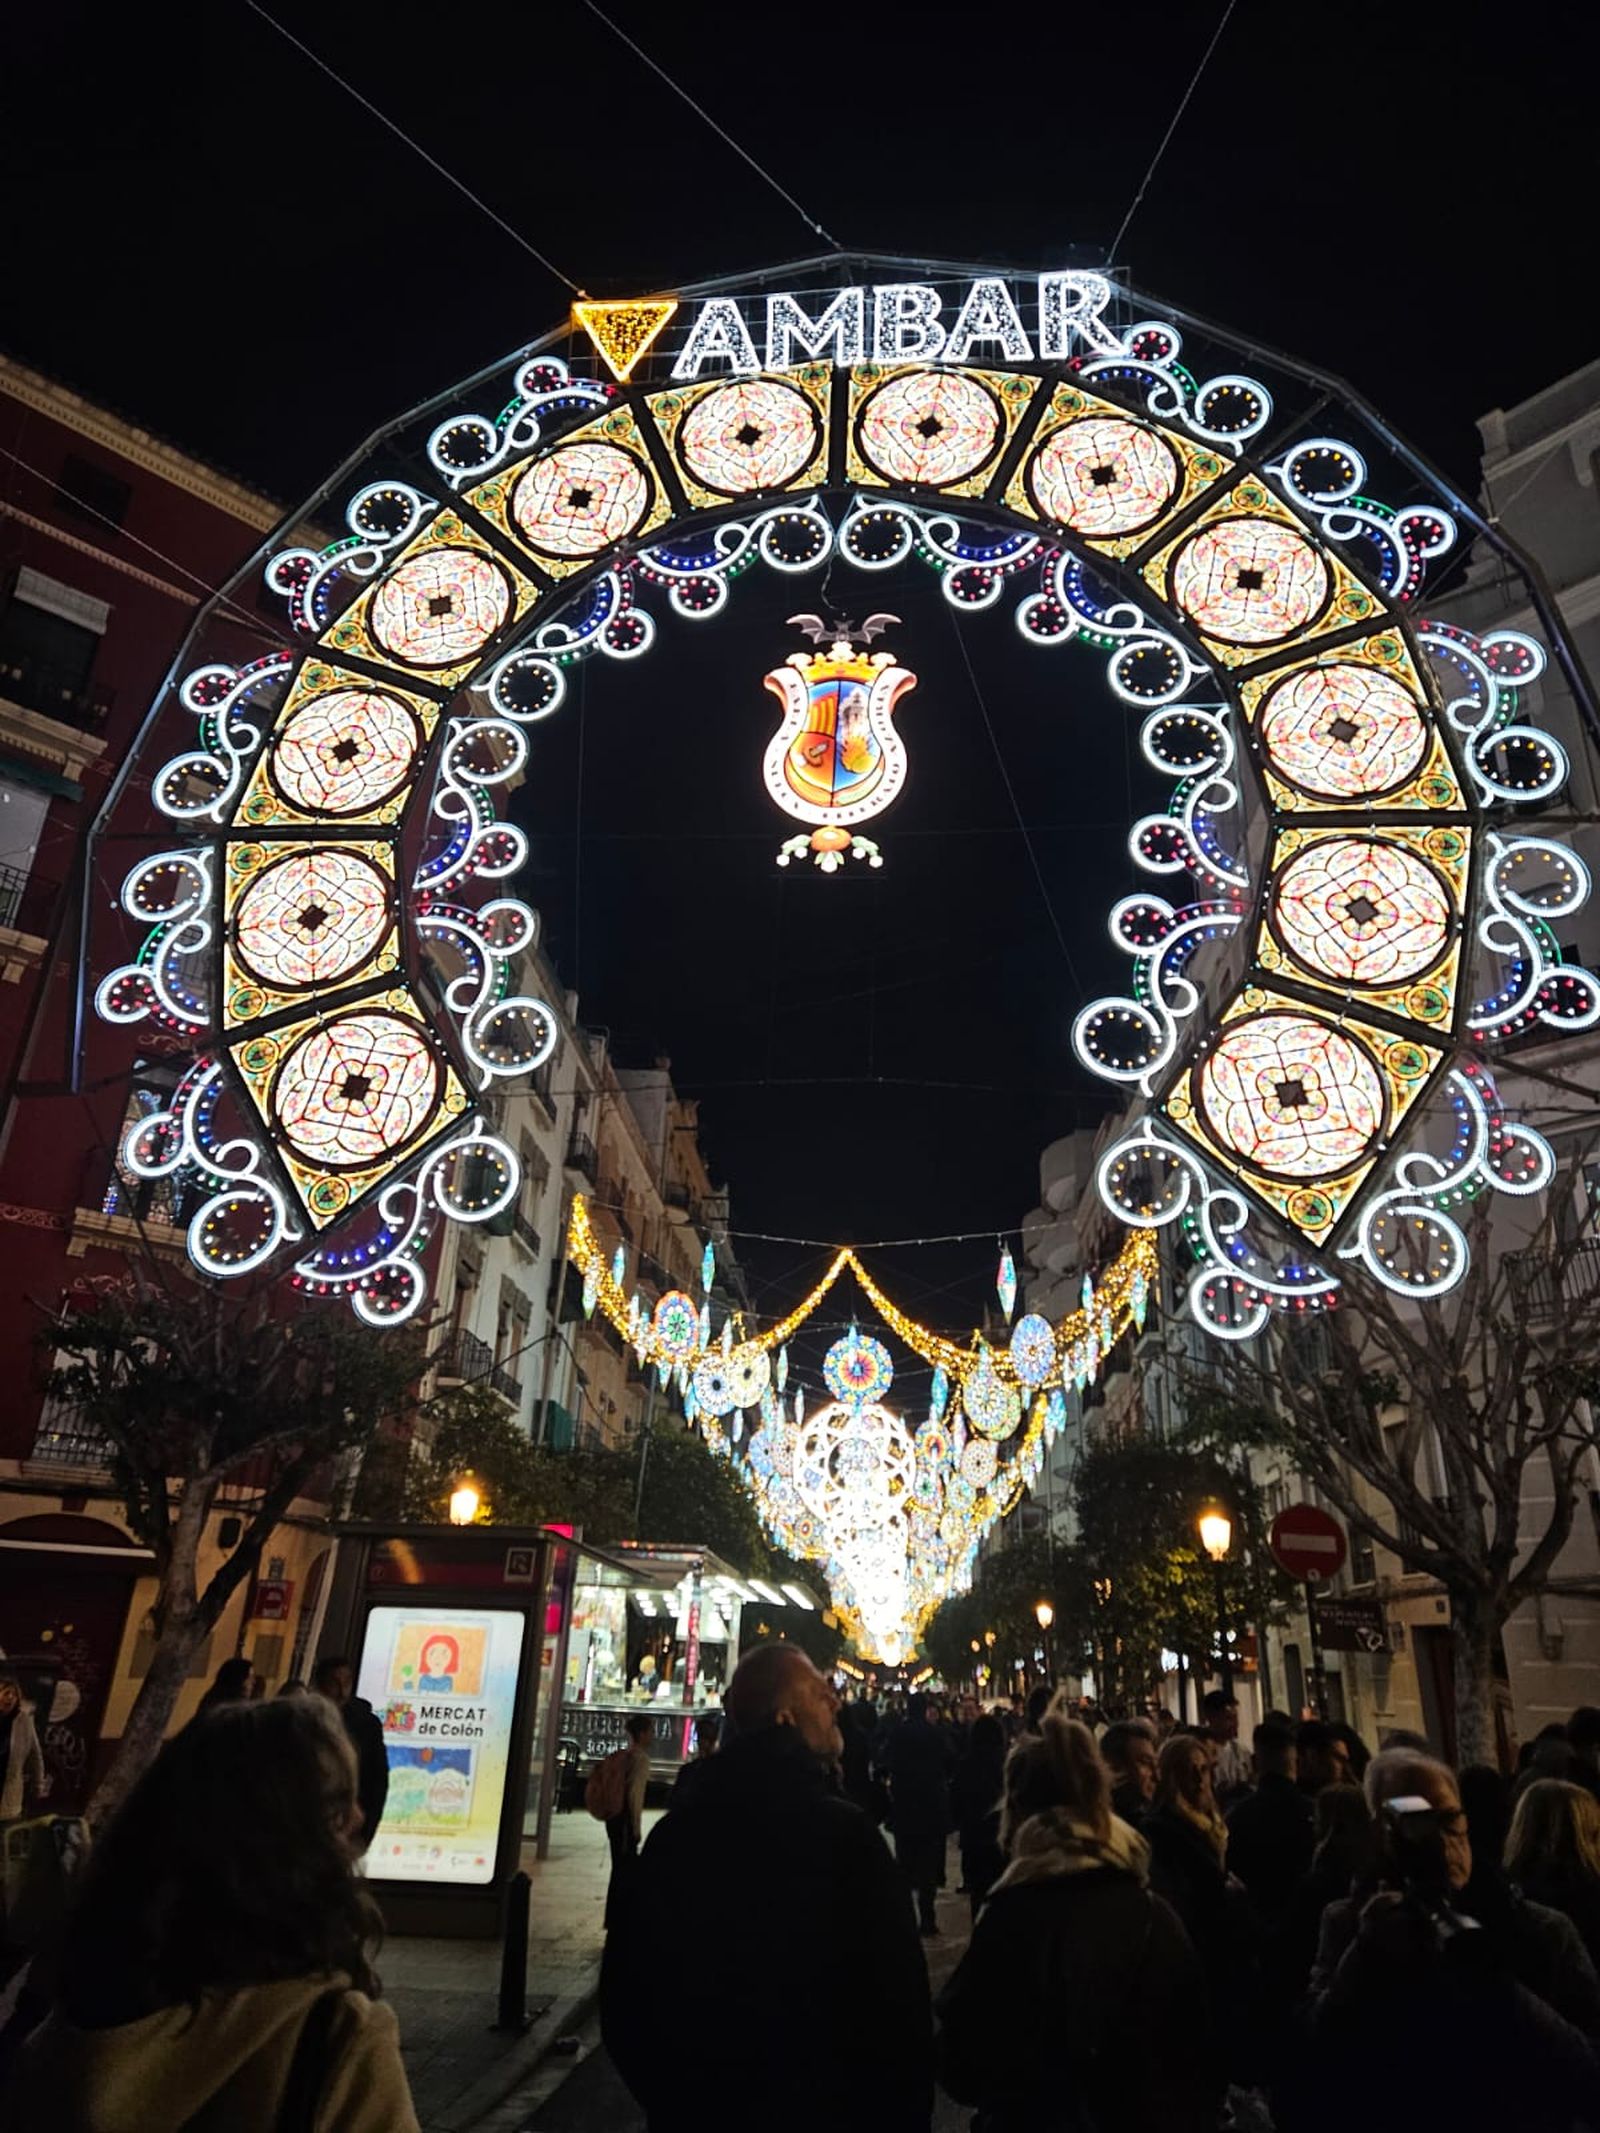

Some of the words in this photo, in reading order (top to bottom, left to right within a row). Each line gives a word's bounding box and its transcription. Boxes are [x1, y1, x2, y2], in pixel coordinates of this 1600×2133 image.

[671, 269, 1128, 380] AMBAR
[420, 1705, 487, 1721] MERCAT
[418, 1722, 437, 1735] de
[440, 1722, 484, 1737] Colón
